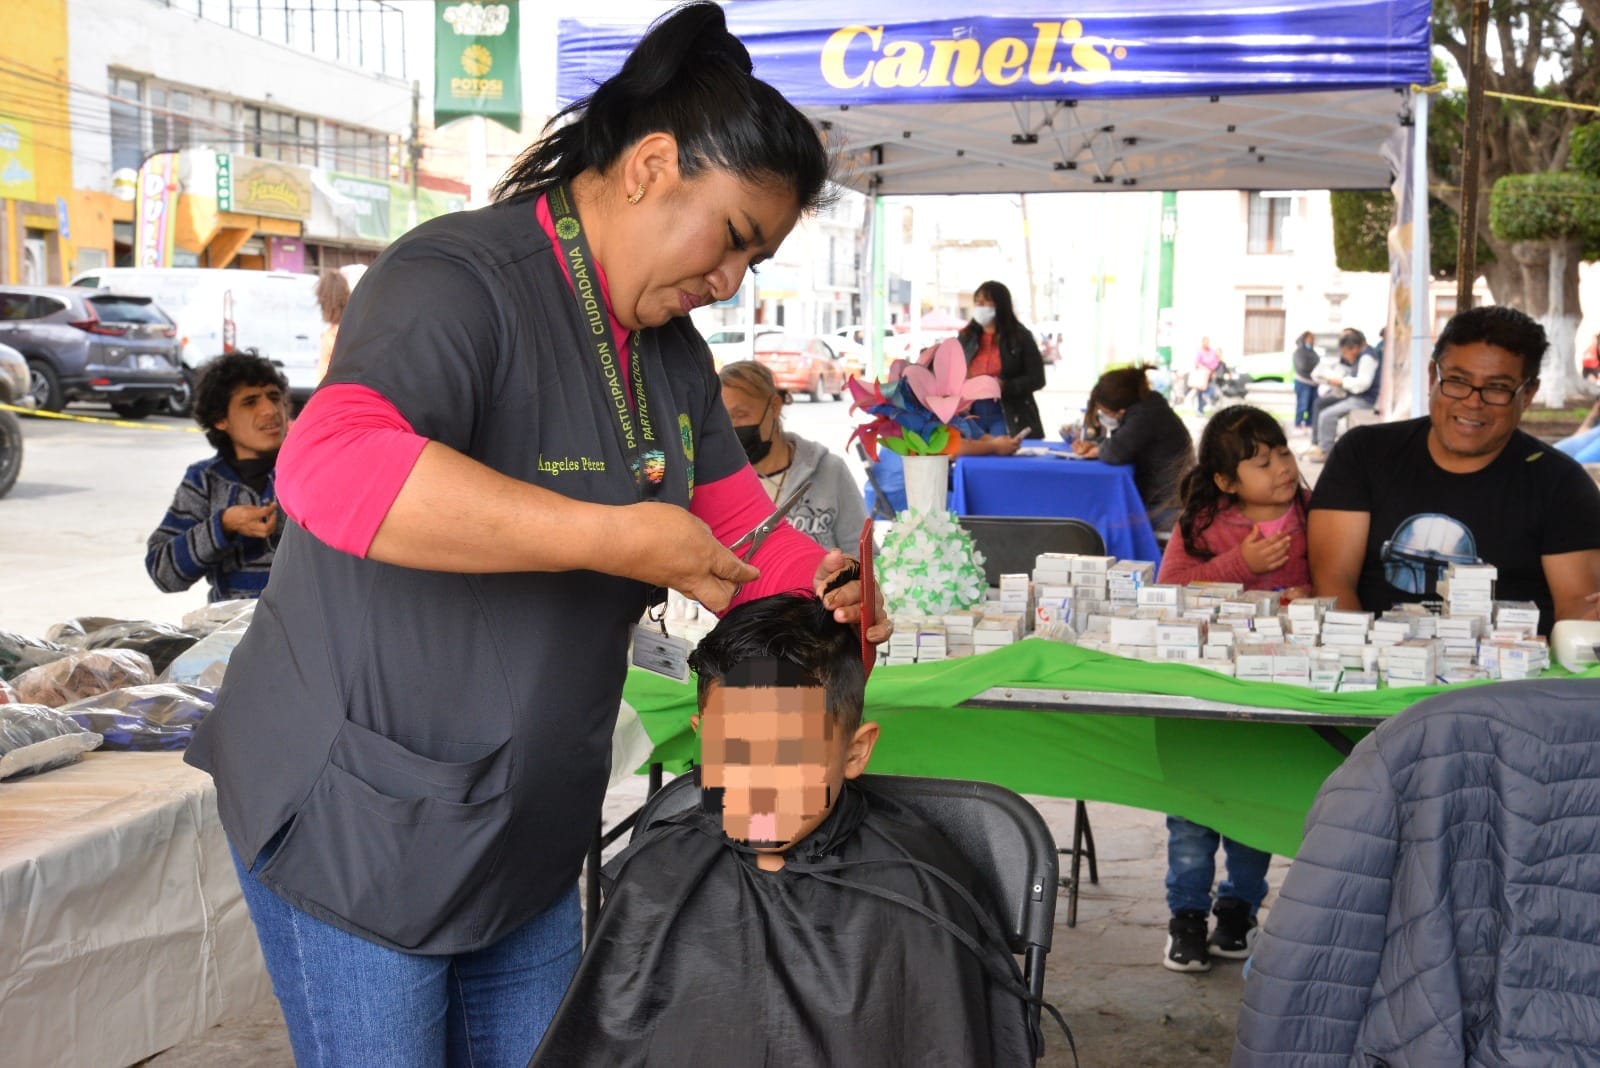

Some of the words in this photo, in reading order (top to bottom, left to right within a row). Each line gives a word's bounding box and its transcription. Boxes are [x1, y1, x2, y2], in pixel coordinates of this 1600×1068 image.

[820, 19, 1112, 89] Canel's
[218, 155, 229, 210] TACOS
[569, 246, 605, 335] CIUDADANA
[597, 341, 637, 449] PARTICIPACION
[632, 351, 655, 441] PARTICIPACION
